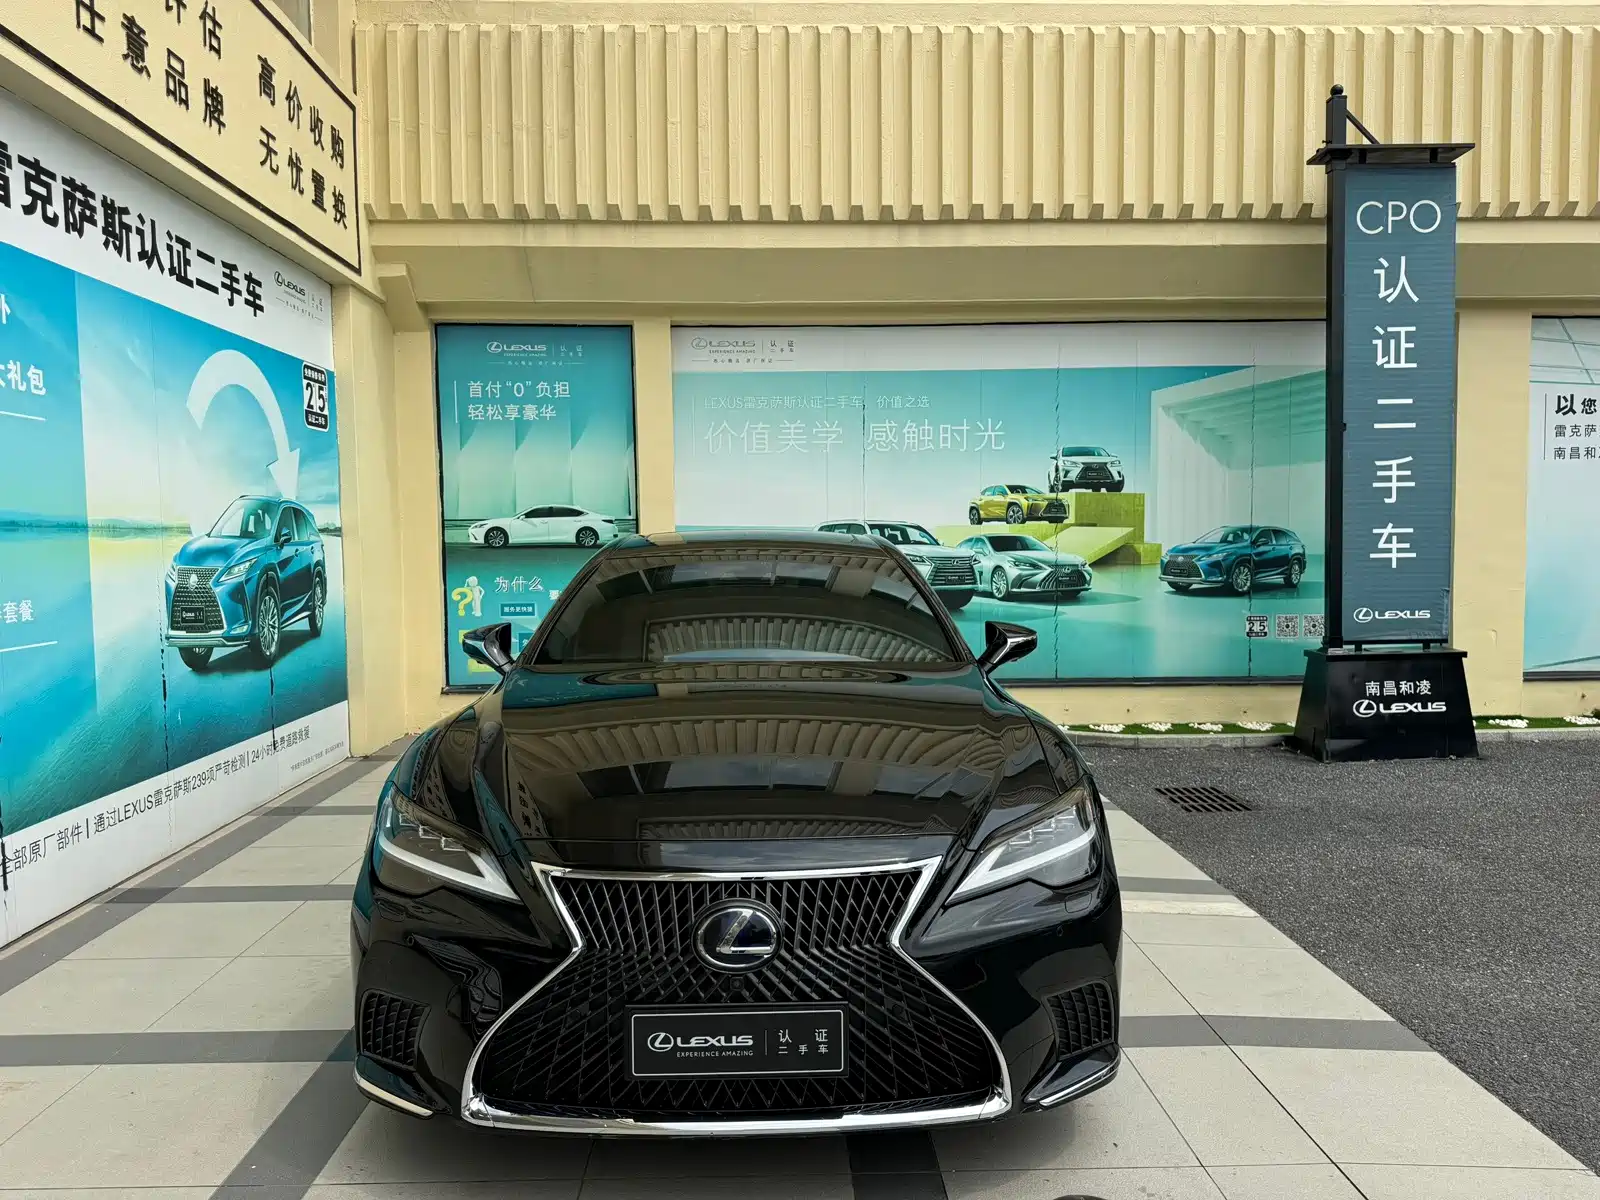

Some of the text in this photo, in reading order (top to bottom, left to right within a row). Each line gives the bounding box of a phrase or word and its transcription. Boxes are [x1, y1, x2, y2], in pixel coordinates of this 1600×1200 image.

[257, 53, 345, 170] 高价收购
[259, 125, 348, 230] 无忧置换
[1356, 199, 1442, 235] CPO
[0, 140, 265, 318] 克萨斯认证二手车
[283, 278, 306, 297] LEXUS
[708, 340, 756, 348] LEXUS
[0, 360, 47, 396] 礼包
[876, 395, 930, 408] 价值之选
[1555, 393, 1598, 416] 以您
[467, 404, 557, 421] 轻松享豪华
[1369, 255, 1420, 569] 认证二手车
[703, 418, 1006, 454] 价值美学 感触时光
[1554, 423, 1600, 438] 雷克萨
[1553, 446, 1600, 460] 南昌和
[494, 576, 545, 594] 为什么
[0, 599, 35, 624] 套餐
[1374, 610, 1431, 620] LEXUS
[1365, 680, 1432, 697] 南昌和凌
[1379, 701, 1447, 713] LEXUS
[676, 1035, 754, 1047] LEXUS
[778, 1029, 829, 1044] 认证
[778, 1044, 829, 1055] 二手车
